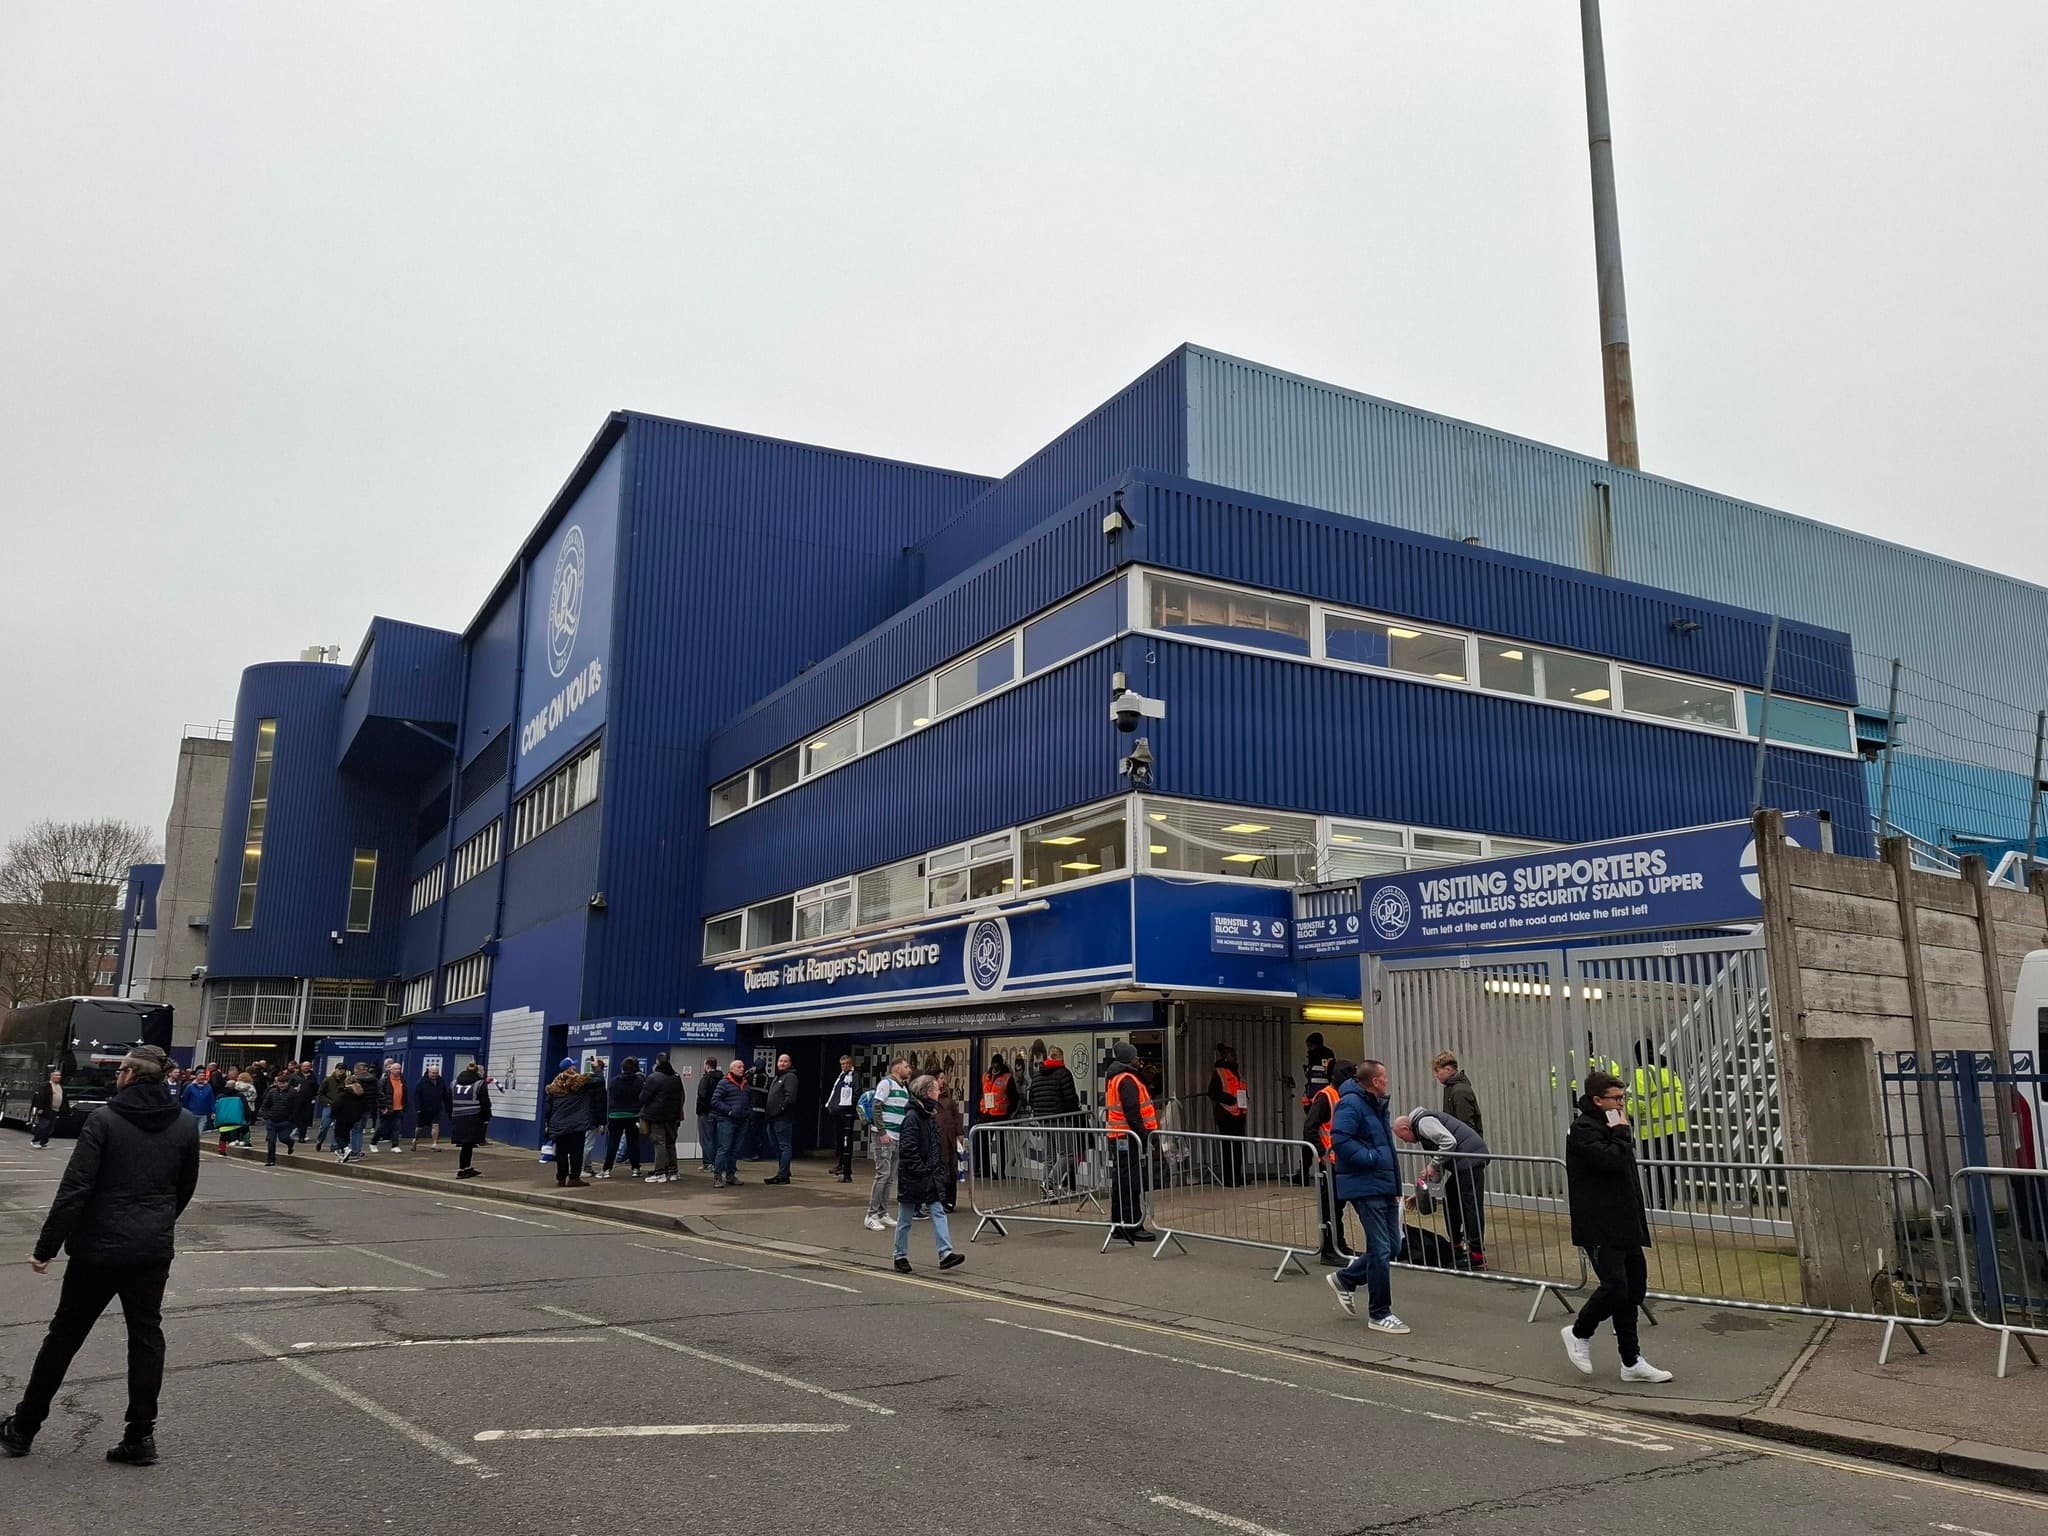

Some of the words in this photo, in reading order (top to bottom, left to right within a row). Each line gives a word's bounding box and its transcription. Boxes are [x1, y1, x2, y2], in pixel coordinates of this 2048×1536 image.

[521, 706, 548, 756] COME
[550, 689, 566, 732] ON
[566, 673, 586, 717] YOU
[1419, 871, 1508, 903] VISITING
[1513, 848, 1667, 893] SUPPORTERS
[1420, 904, 1443, 920] THE
[1446, 894, 1516, 916] ACHILLEUS
[1519, 886, 1588, 909] SECURITY
[1592, 879, 1644, 901] STAND
[1649, 872, 1704, 894] UPPER
[1215, 917, 1248, 928] TURNSTILE
[1296, 920, 1326, 930] TURNSTILE
[1329, 919, 1337, 934] 3
[1422, 926, 1438, 936] Turn
[1440, 923, 1454, 934] left
[1454, 922, 1464, 932] at
[1465, 922, 1478, 932] the
[1480, 920, 1496, 930] end
[1498, 918, 1508, 928] of
[1509, 916, 1523, 928] the
[1526, 914, 1547, 926] road
[1549, 912, 1568, 924] and
[1570, 910, 1591, 920] take
[1593, 908, 1609, 920] the
[1611, 906, 1629, 917] first
[1632, 904, 1649, 915] left
[1216, 925, 1239, 934] BLOCK
[1252, 920, 1262, 936] 3
[1297, 929, 1318, 938] BLOCK
[744, 968, 780, 994] Queens
[783, 960, 806, 985] Park
[807, 956, 857, 984] Rangers
[945, 1010, 1006, 1026] www.shop.qpr.co.uk
[642, 1022, 650, 1031] 4
[456, 1084, 472, 1094] T7
